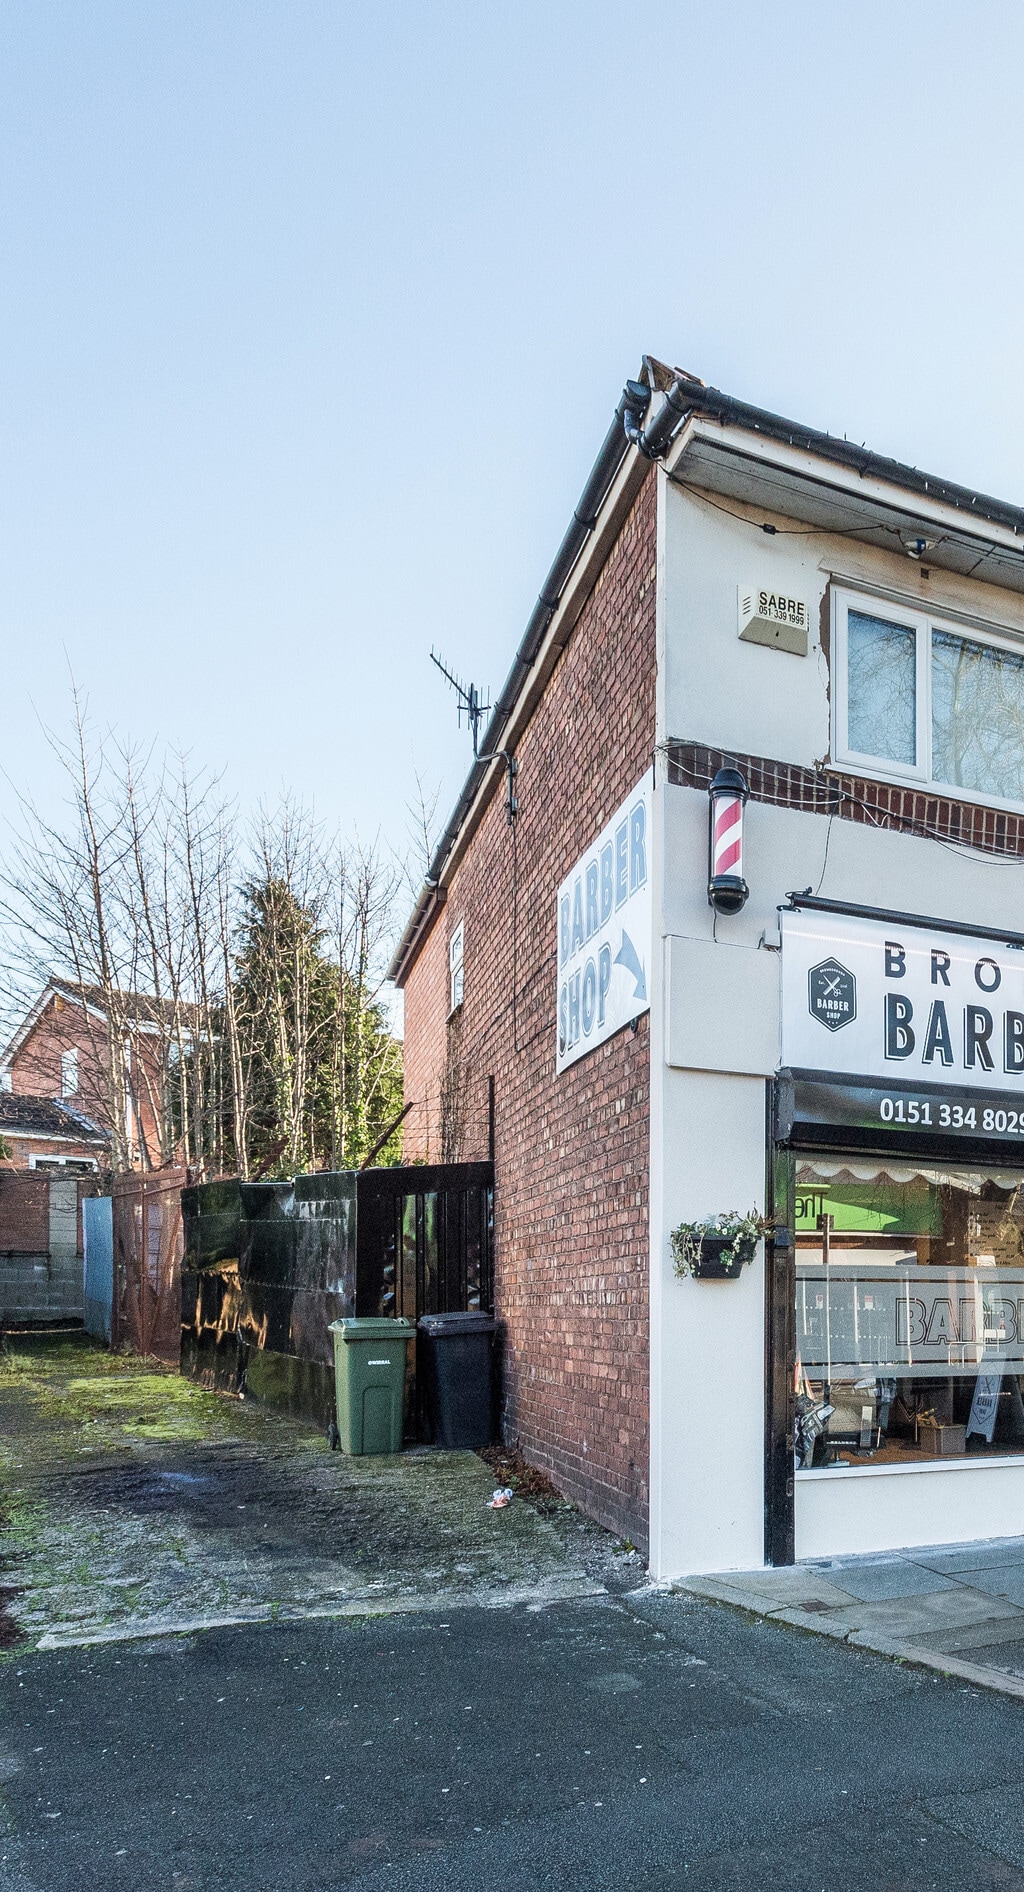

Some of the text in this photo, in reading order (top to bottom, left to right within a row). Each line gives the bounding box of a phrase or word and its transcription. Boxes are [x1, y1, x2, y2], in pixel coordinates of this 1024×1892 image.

[759, 592, 805, 615] SABRE
[759, 605, 804, 625] 051 339 1999
[559, 799, 649, 972] BARBER
[558, 941, 612, 1058] SHOP
[817, 998, 849, 1012] BARBER
[826, 1011, 841, 1020] SHOP
[879, 1098, 932, 1126] 0151
[938, 1104, 977, 1129] 334
